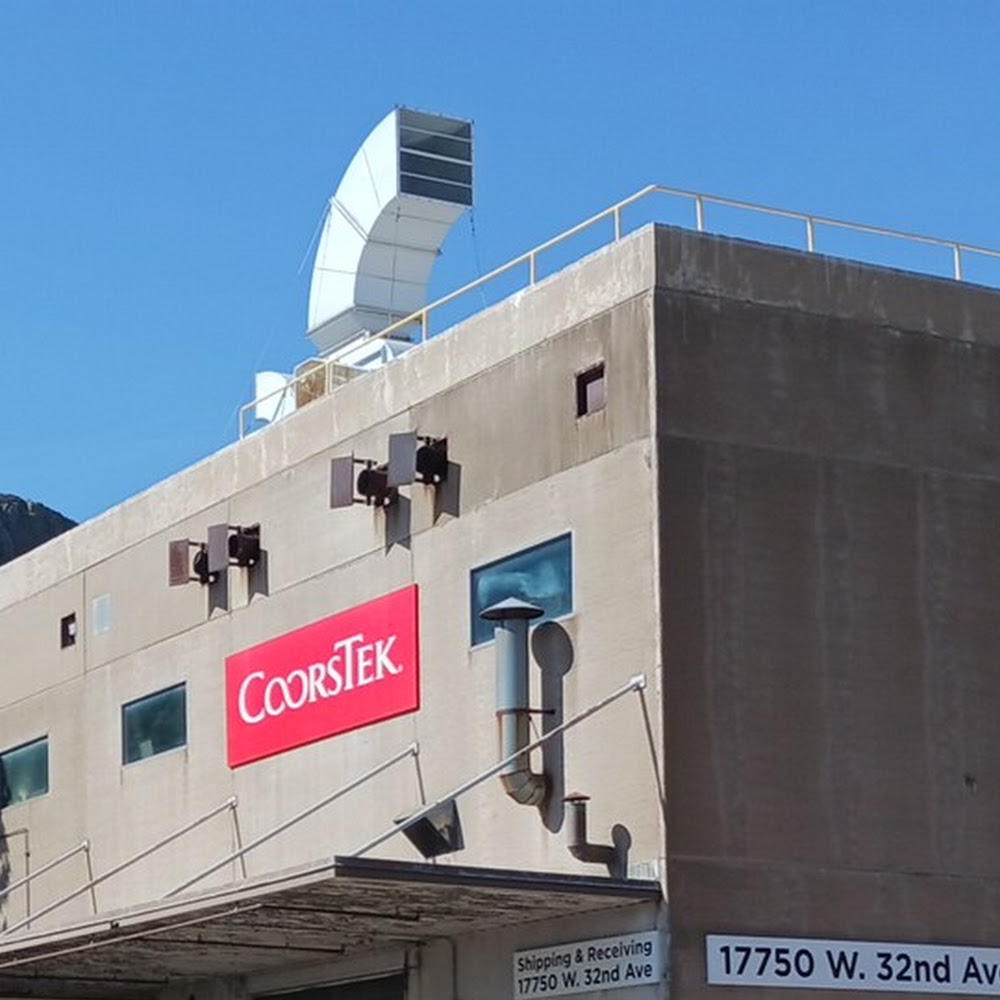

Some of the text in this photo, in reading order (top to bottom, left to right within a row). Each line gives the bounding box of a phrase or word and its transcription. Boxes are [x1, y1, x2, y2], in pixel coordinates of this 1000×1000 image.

[517, 940, 652, 972] Shipping & Receiving
[719, 946, 814, 978] 17750
[826, 950, 865, 979] W.
[877, 953, 950, 983] 32nd
[517, 963, 652, 994] 17750 W. 32nd Ave
